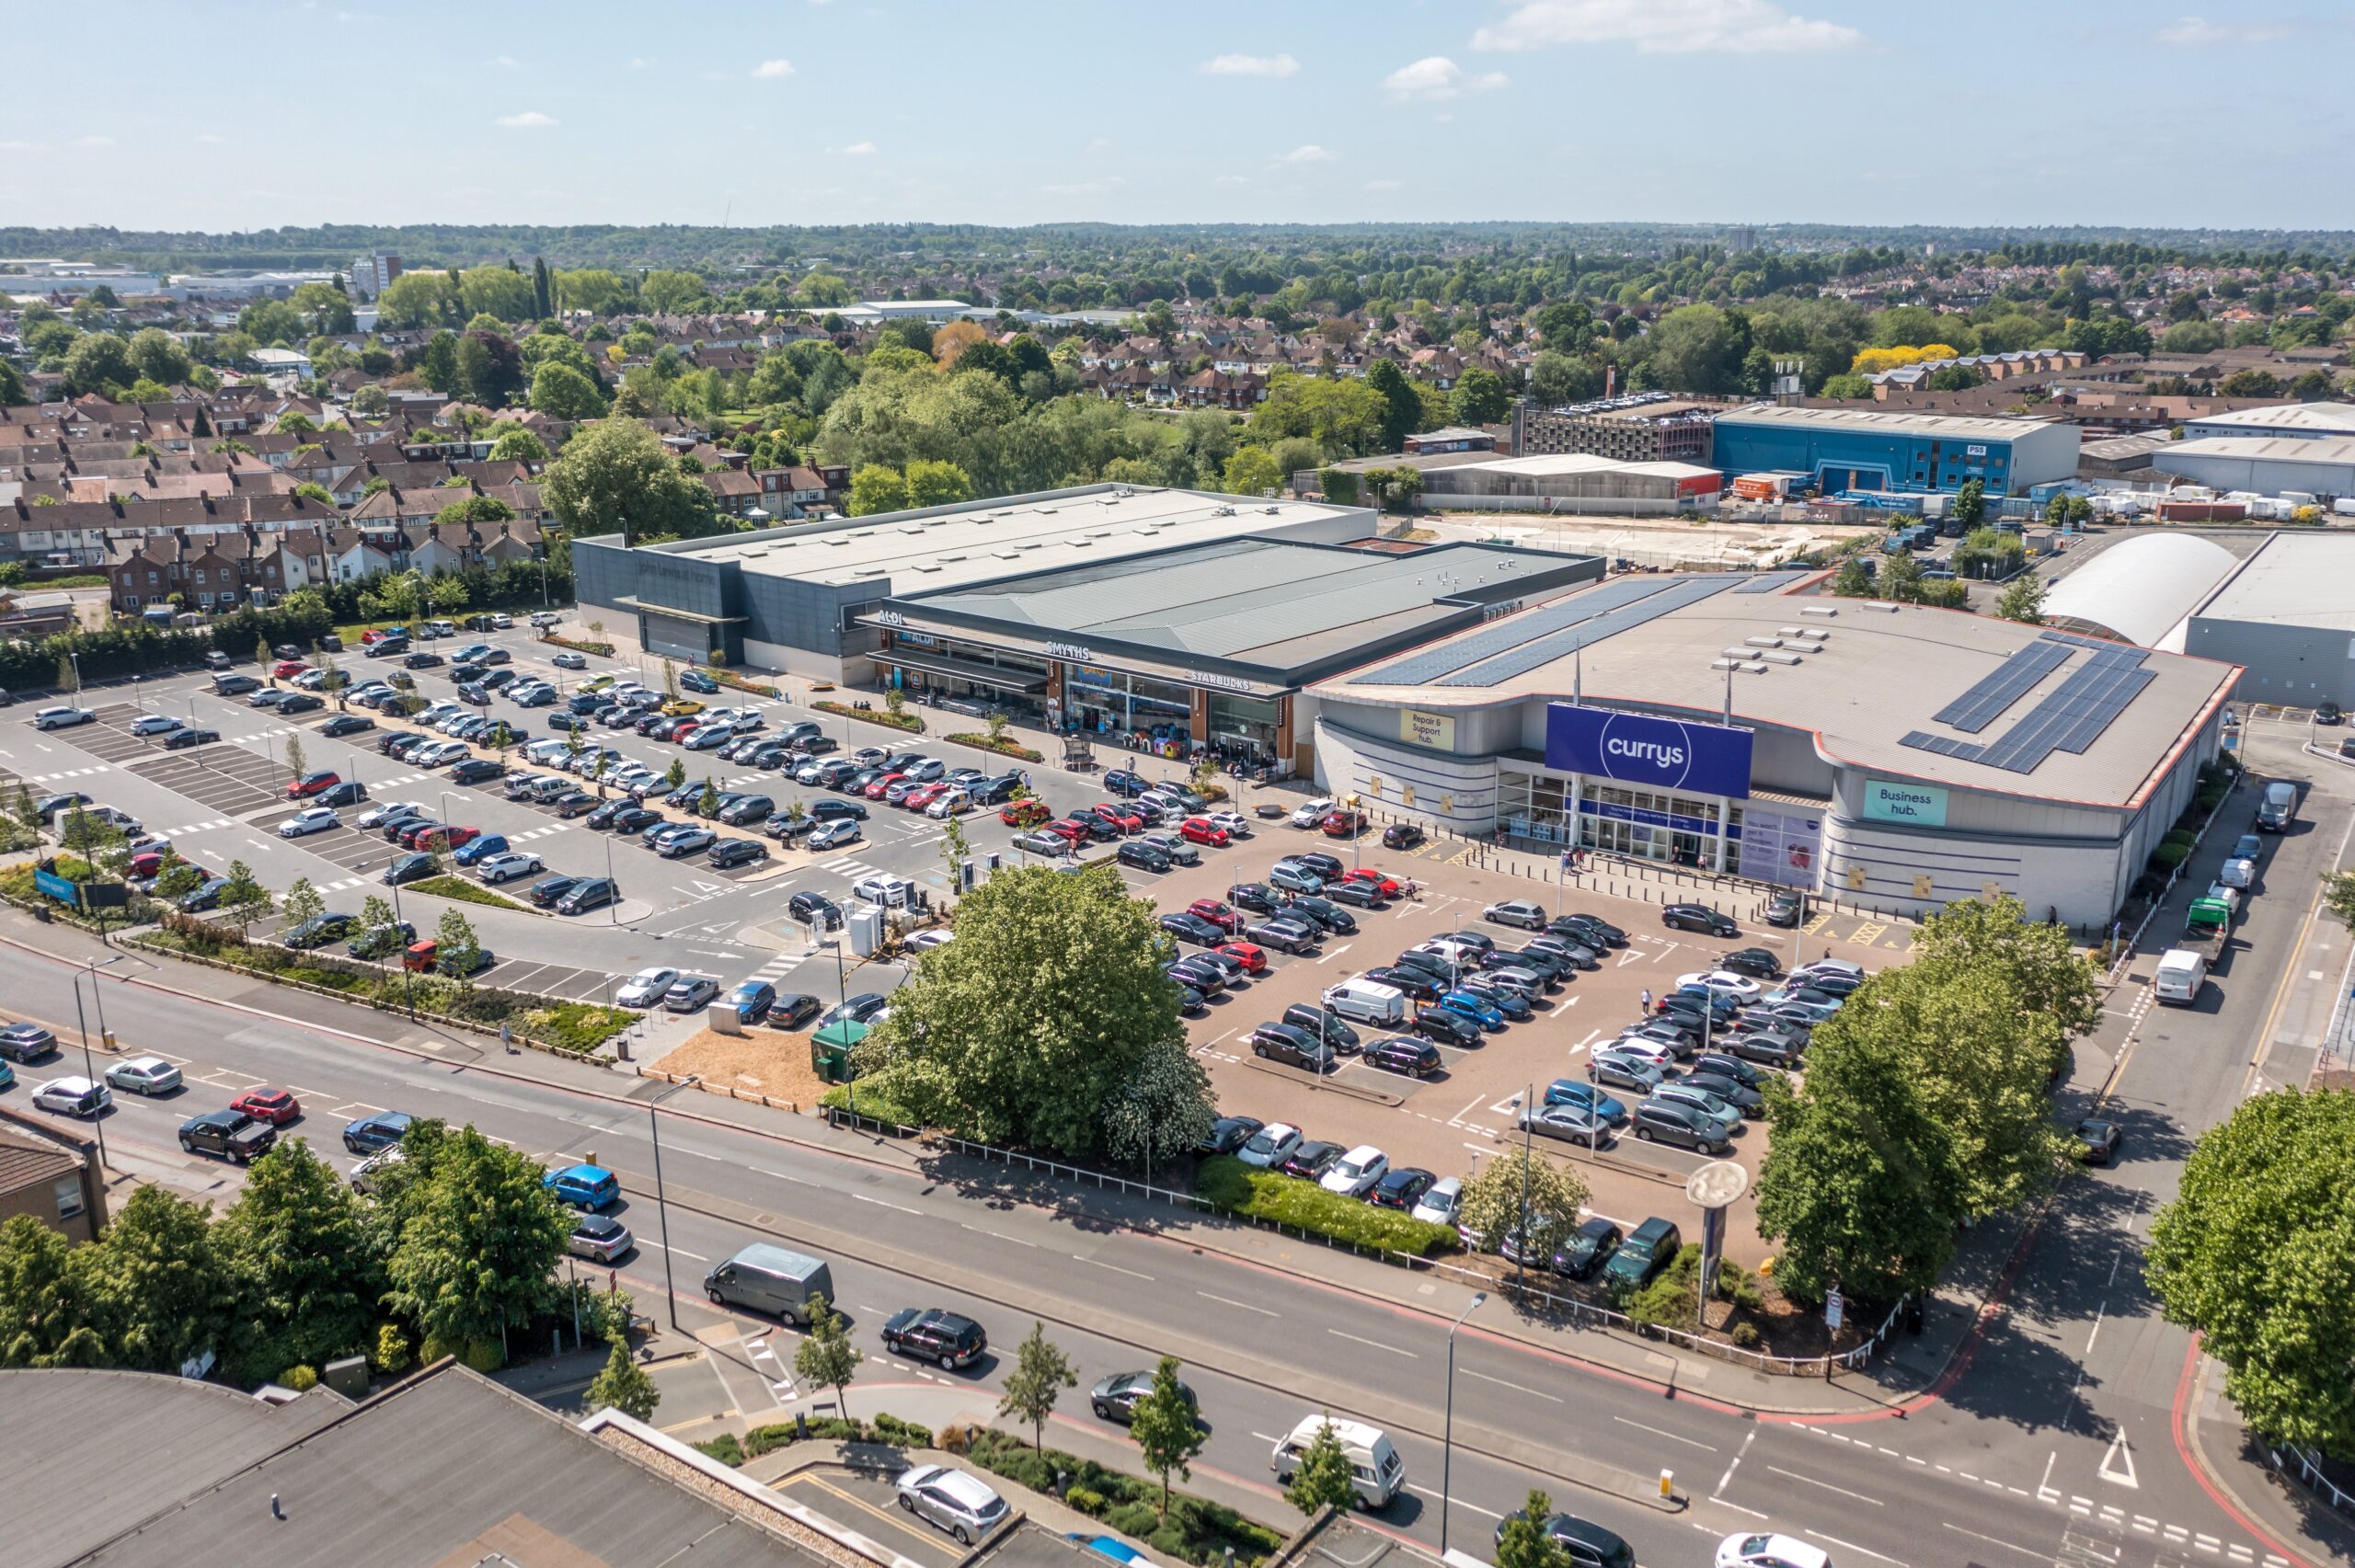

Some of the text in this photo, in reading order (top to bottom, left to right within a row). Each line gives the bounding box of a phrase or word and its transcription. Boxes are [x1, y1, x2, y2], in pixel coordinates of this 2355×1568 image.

[879, 610, 902, 625] ALDI
[1046, 641, 1089, 660] SMYTHS
[1191, 671, 1250, 690] STARBUCKS
[1412, 714, 1435, 726] Repair
[1412, 724, 1441, 736] Support
[1419, 734, 1433, 744] hub.
[1607, 738, 1684, 769] currys
[1879, 789, 1932, 804] Business
[1890, 804, 1917, 816] hub.
